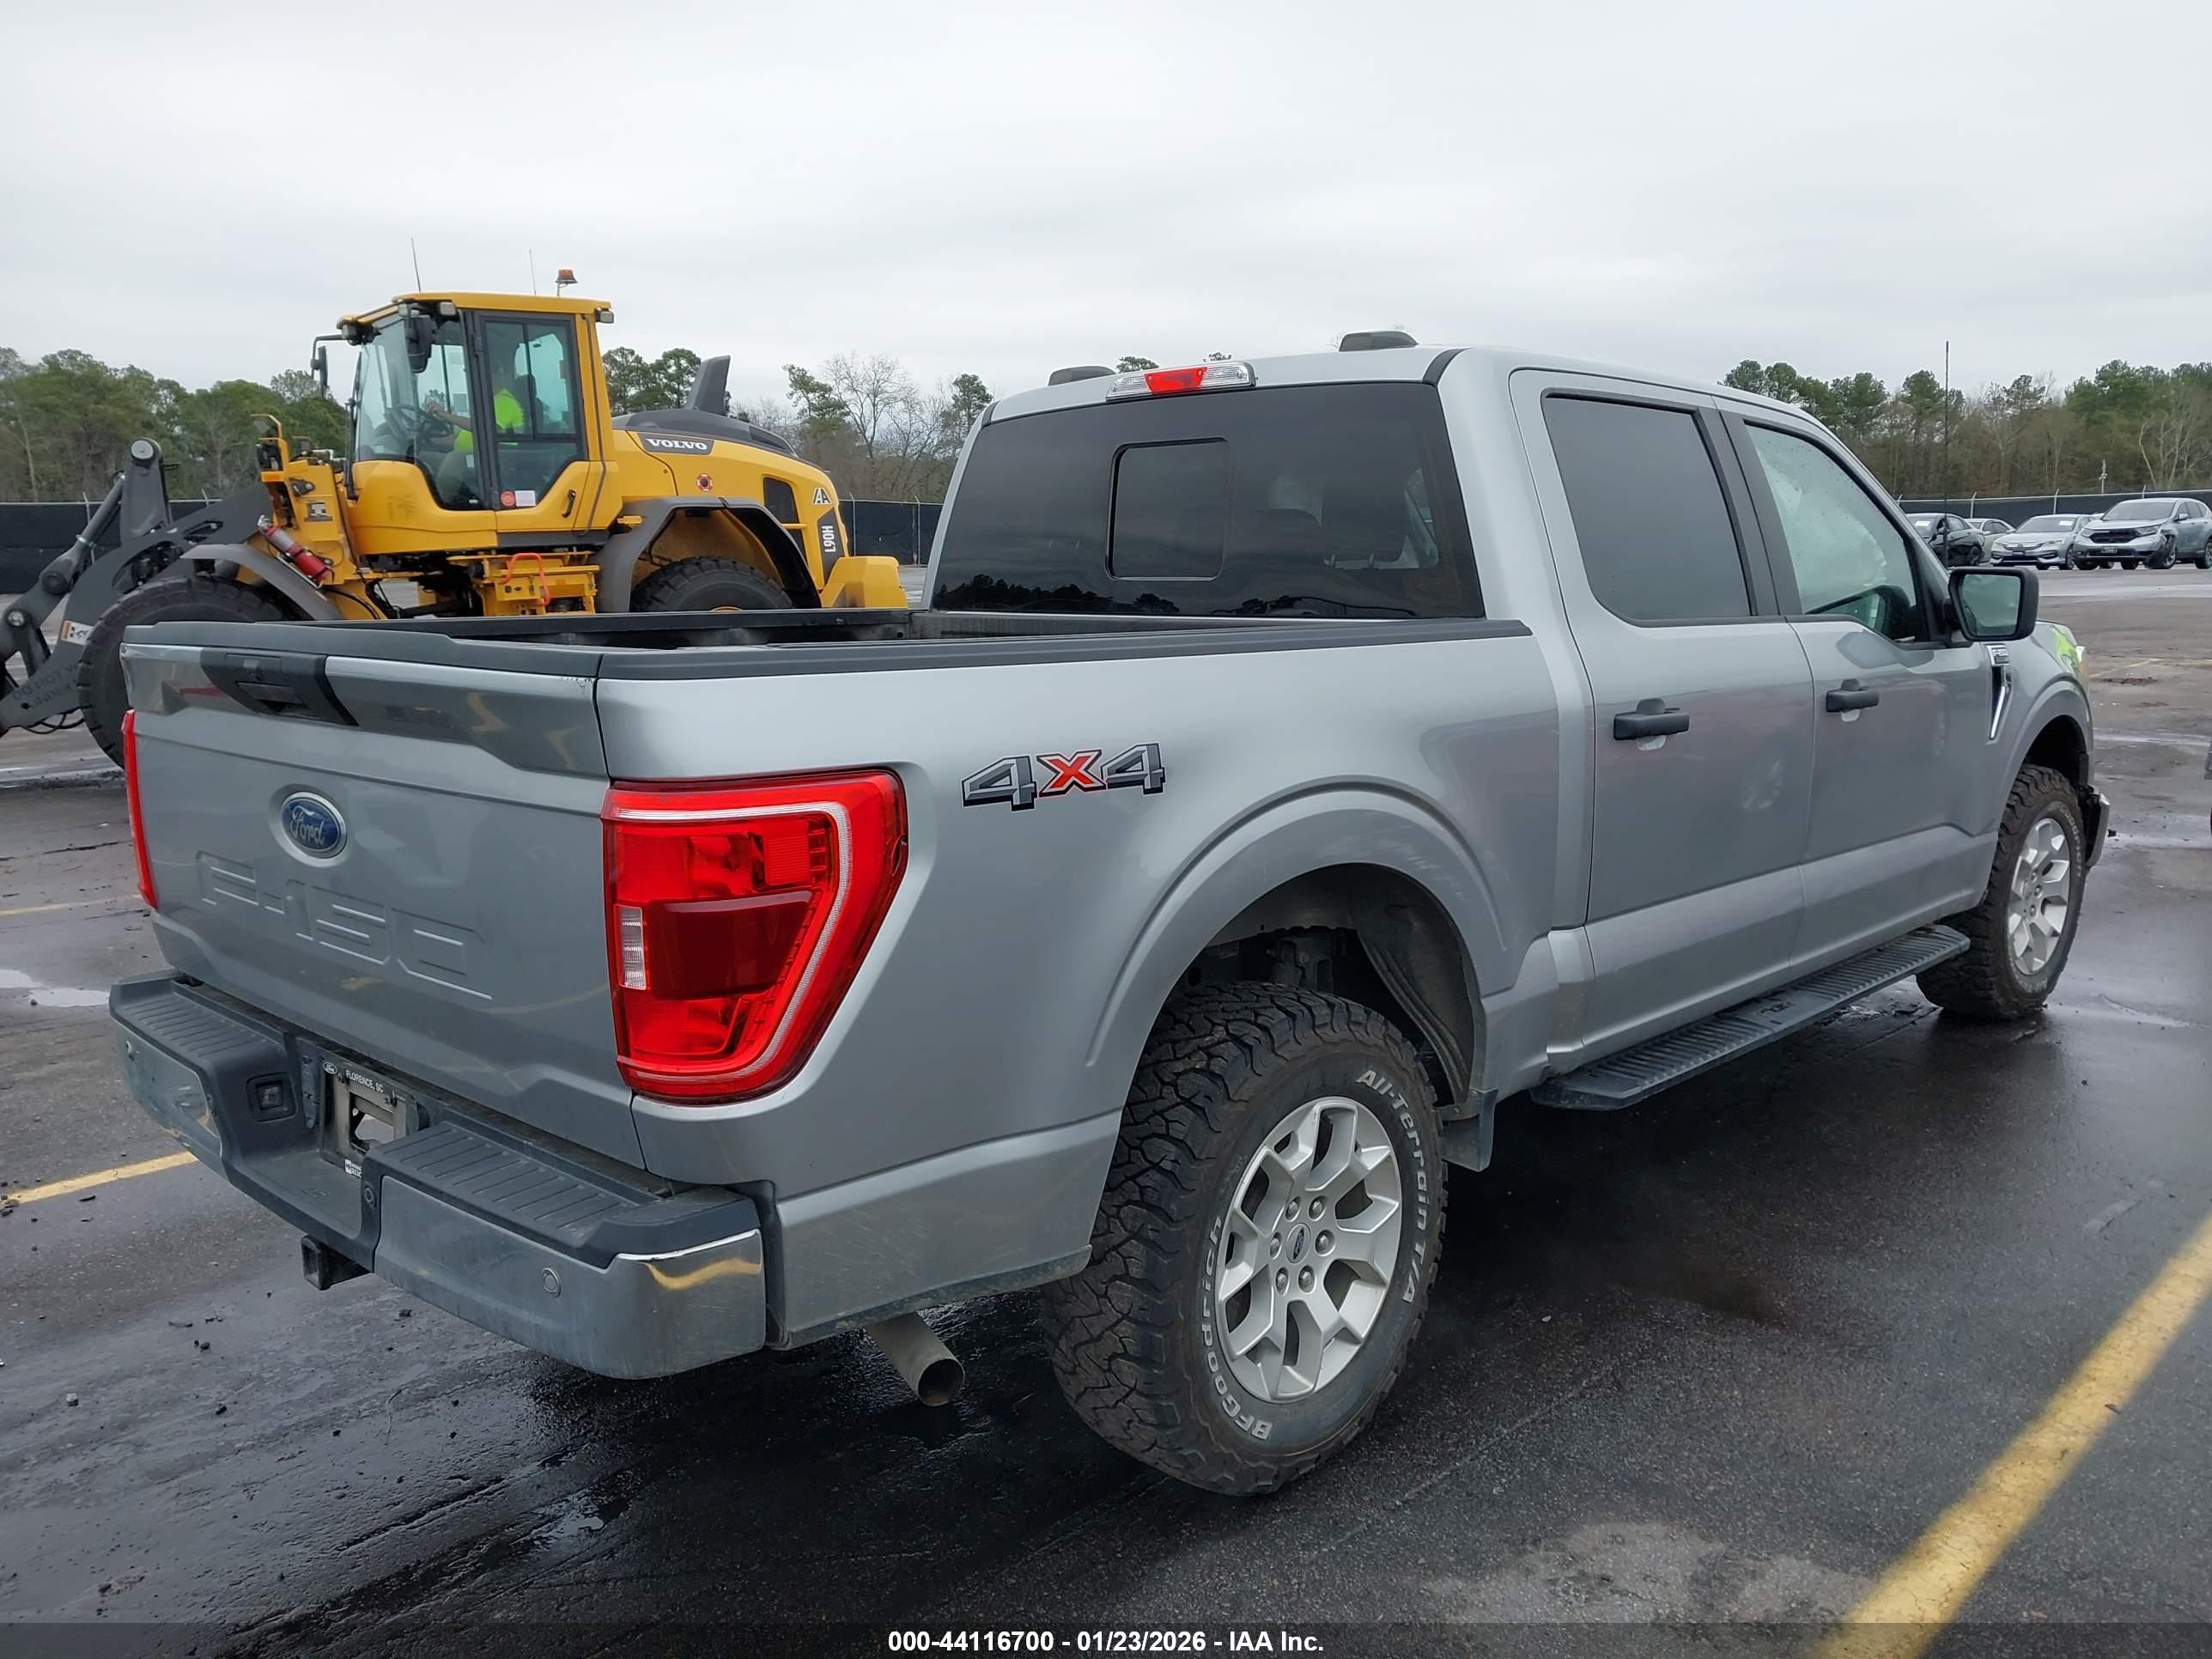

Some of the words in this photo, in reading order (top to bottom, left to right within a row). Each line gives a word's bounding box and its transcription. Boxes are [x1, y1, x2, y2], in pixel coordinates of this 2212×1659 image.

[645, 438, 708, 450] VOLVO
[822, 525, 836, 553] L90H
[289, 805, 325, 846] Ford
[345, 1069, 375, 1091] FLORENCE,
[375, 1082, 385, 1094] SC
[1356, 1070, 1429, 1231] All-Terrain
[1401, 1241, 1426, 1303] T/A
[1202, 1216, 1273, 1440] BFGoodrich
